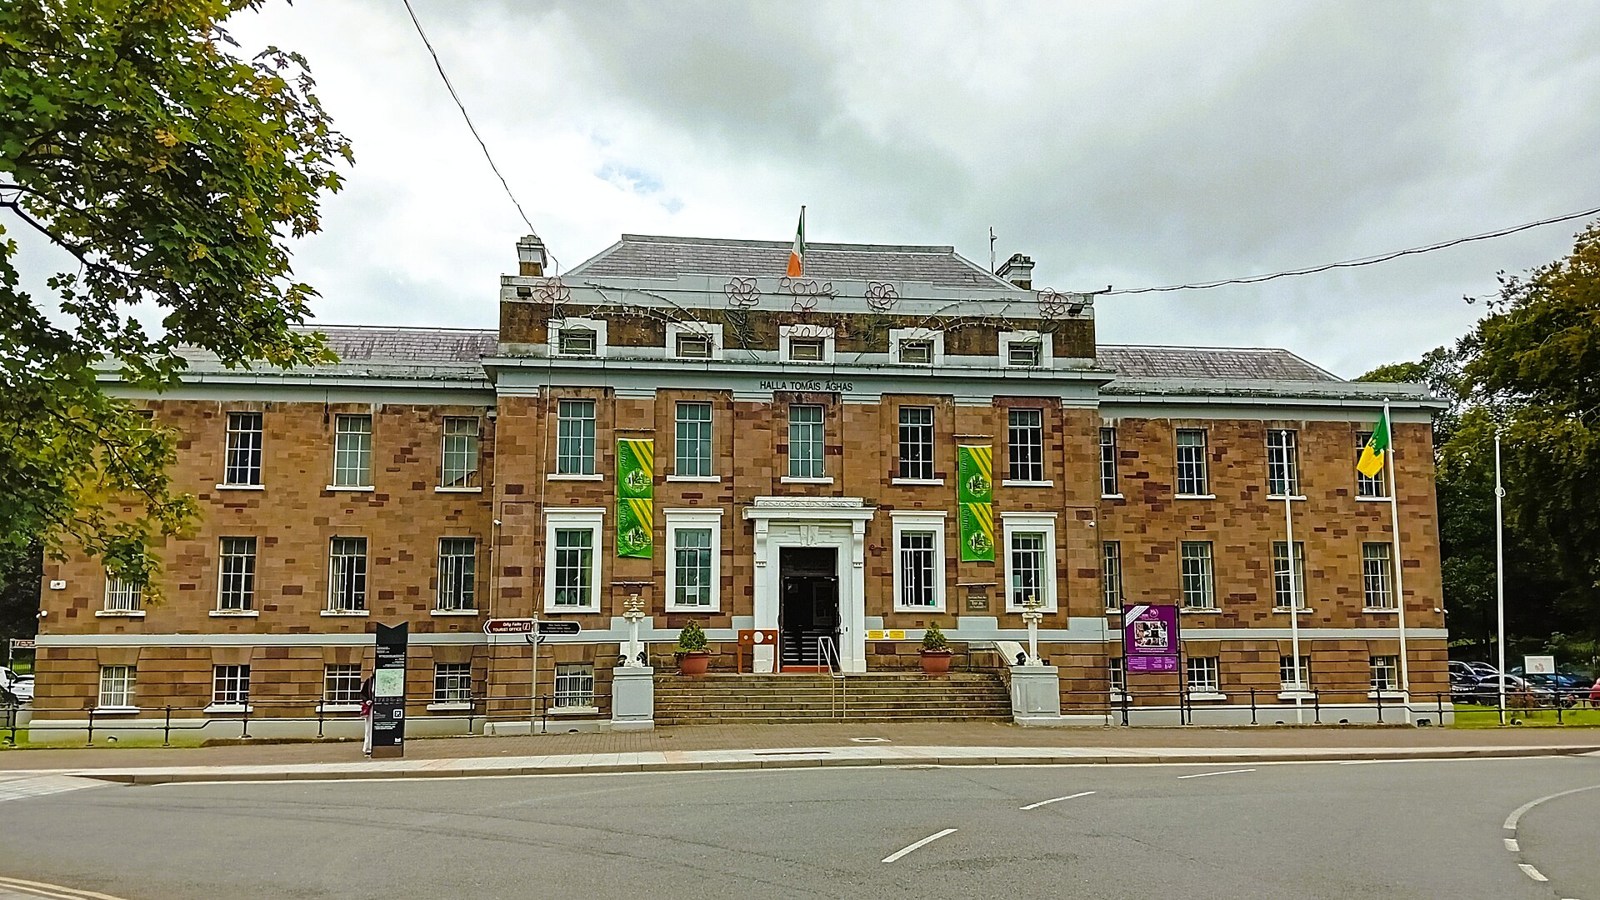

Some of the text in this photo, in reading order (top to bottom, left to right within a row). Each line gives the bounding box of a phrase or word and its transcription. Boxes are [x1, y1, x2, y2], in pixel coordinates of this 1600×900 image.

[760, 379, 853, 391] HALLA TOMÁIS ÁGHAS
